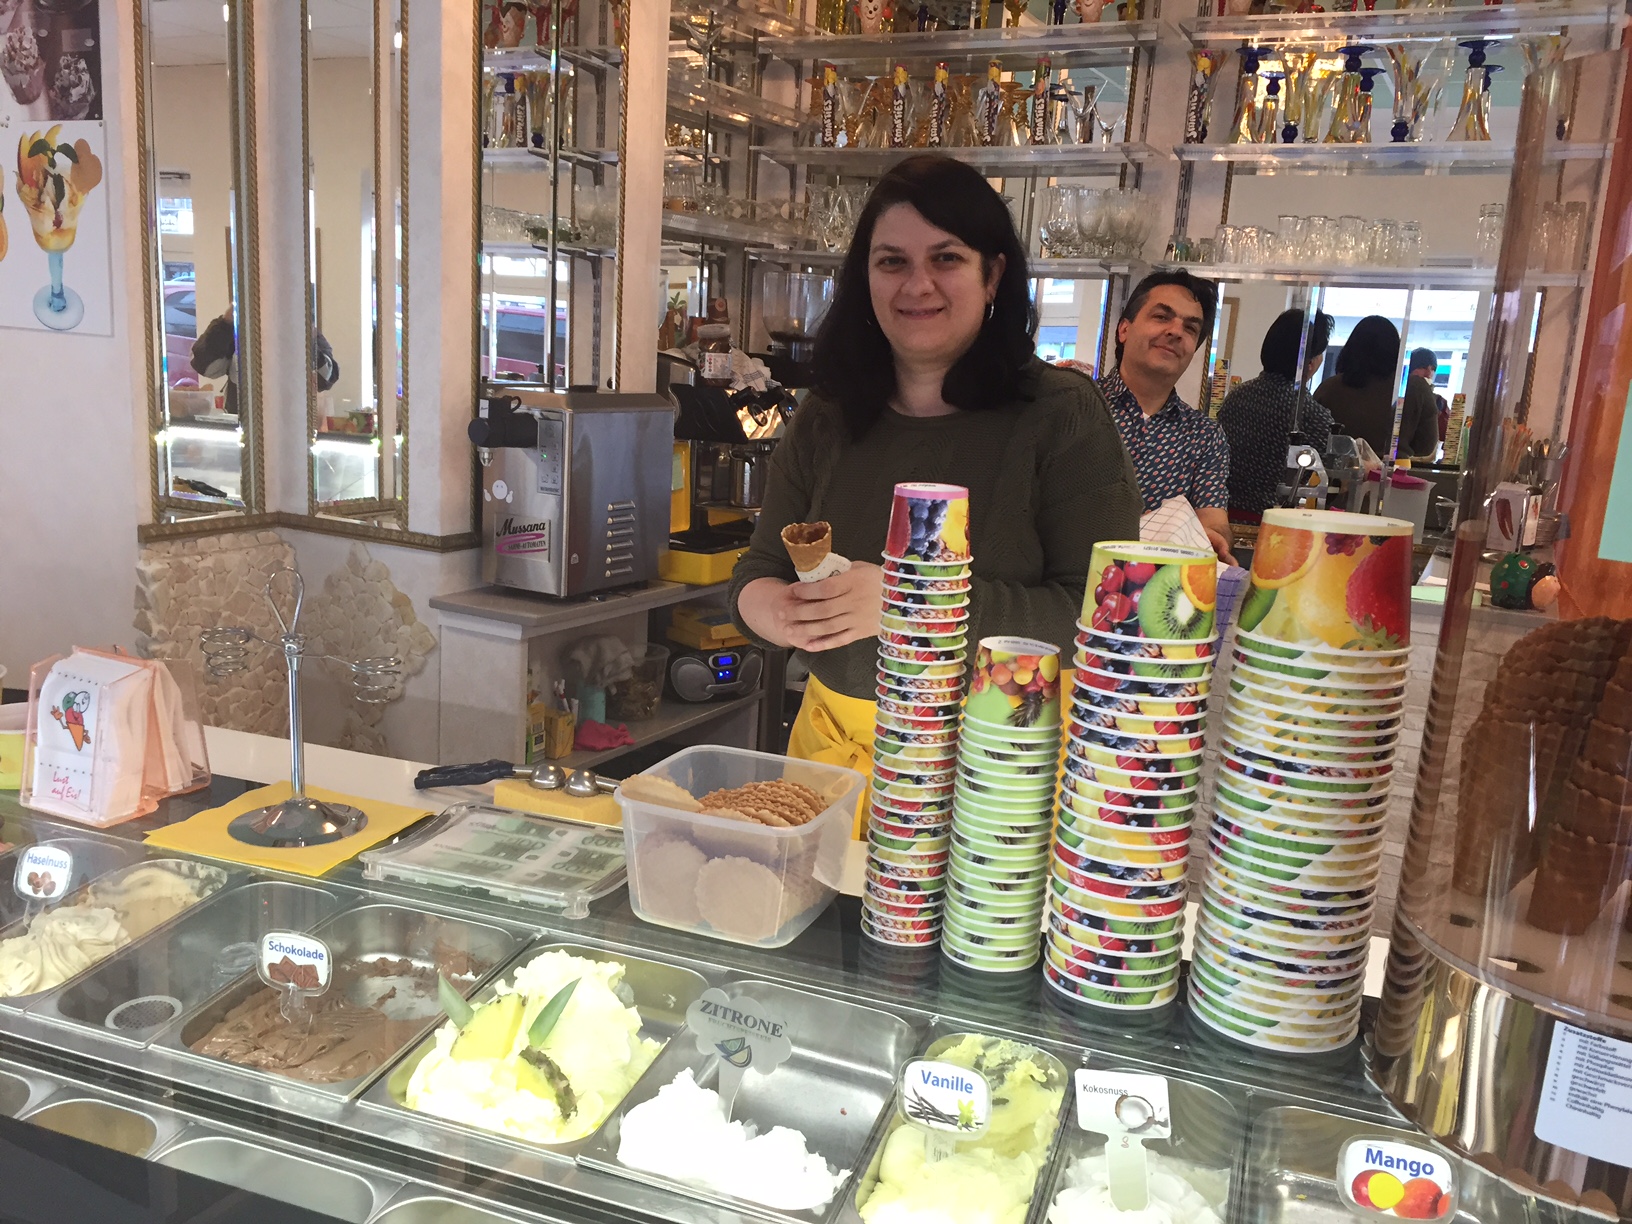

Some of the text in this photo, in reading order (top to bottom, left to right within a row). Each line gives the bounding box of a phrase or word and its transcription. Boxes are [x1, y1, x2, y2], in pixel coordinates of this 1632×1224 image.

[823, 99, 834, 143] SMARTIES
[893, 99, 904, 143] SMARTIES
[1035, 98, 1045, 142] SMARTIES
[496, 517, 546, 537] Mussana
[52, 771, 70, 785] Lust
[26, 852, 68, 869] Haselnuss
[268, 940, 325, 960] Schokolade
[700, 1000, 783, 1038] ZITRONE
[921, 1069, 974, 1094] Vanille
[1082, 1084, 1128, 1096] Kokosnuss
[1365, 1148, 1434, 1177] Mango
